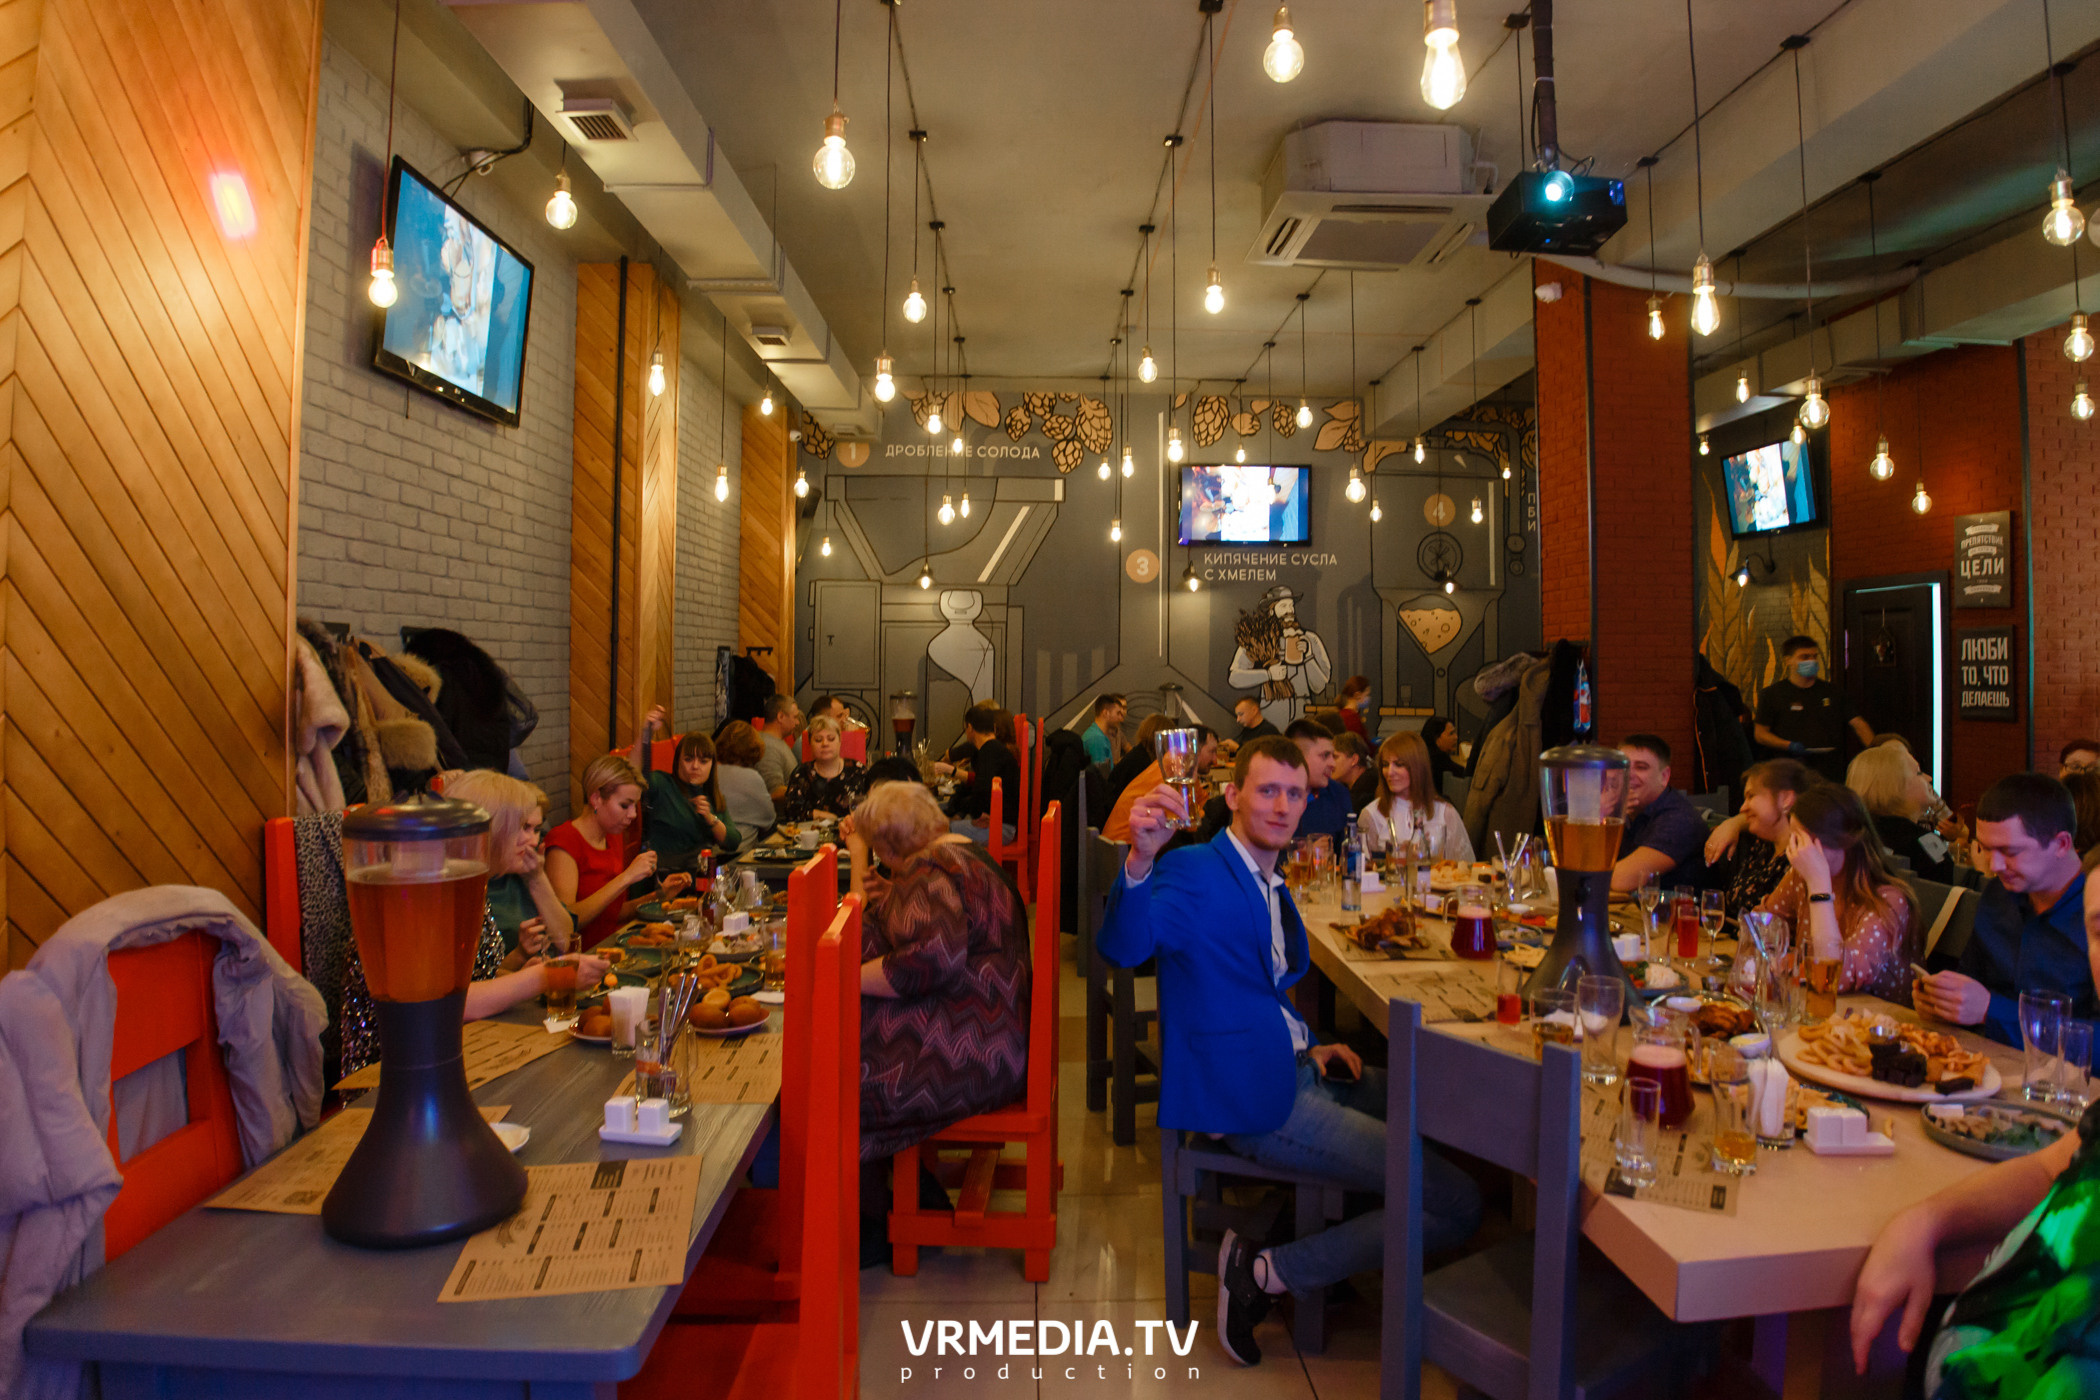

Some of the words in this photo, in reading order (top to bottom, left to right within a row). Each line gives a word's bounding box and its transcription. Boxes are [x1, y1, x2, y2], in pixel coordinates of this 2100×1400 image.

[976, 445, 1040, 459] СОЛОДА
[1433, 502, 1446, 520] 4
[1136, 557, 1149, 576] 3
[1204, 552, 1287, 566] КИПЯЧЕНИЕ
[1291, 553, 1338, 566] СУСЛА
[1960, 557, 2004, 579] ЦЕЛИ
[1204, 568, 1214, 581] С
[1218, 568, 1277, 581] ХМЕЛЕМ
[1961, 637, 2008, 661] ЛЮБИ
[1962, 665, 1981, 687] ТО,
[1983, 665, 2009, 686] ЧТО
[1961, 690, 2010, 708] ДЕЛАЕШЬ
